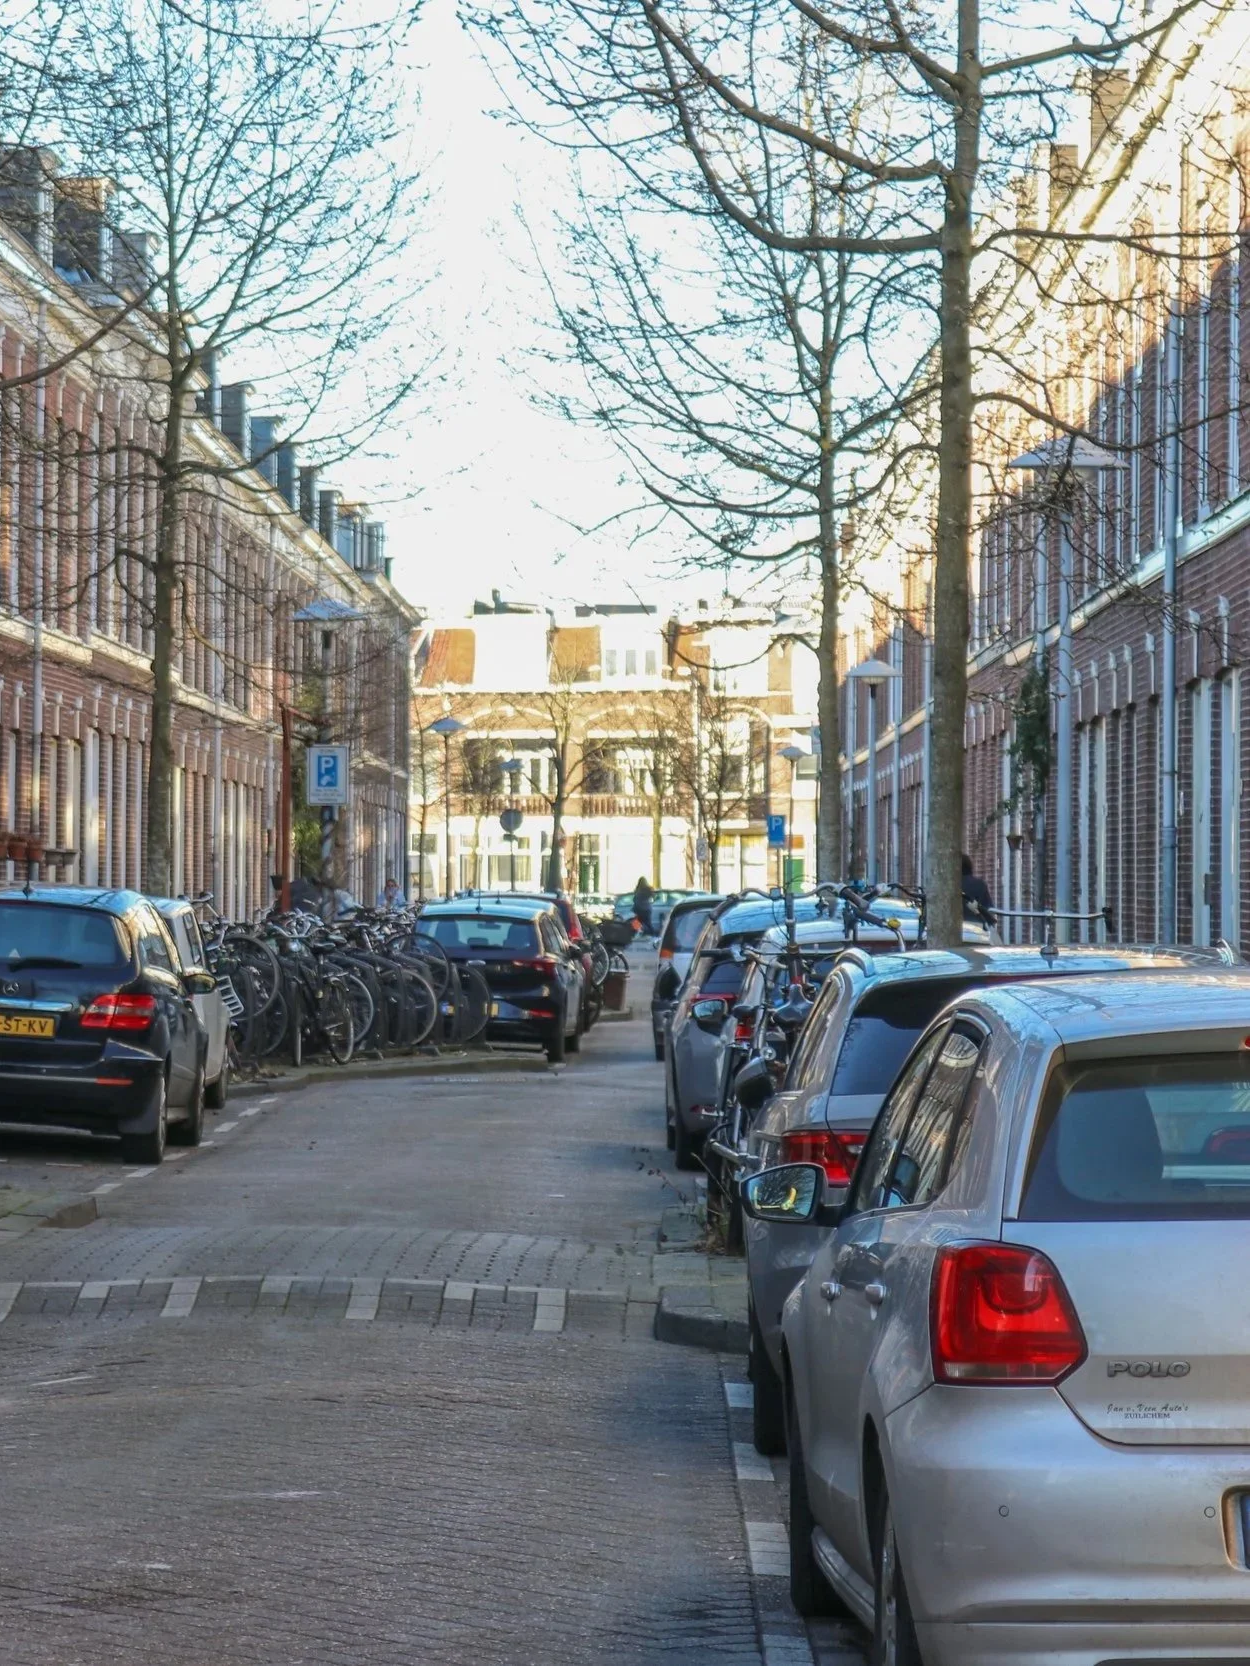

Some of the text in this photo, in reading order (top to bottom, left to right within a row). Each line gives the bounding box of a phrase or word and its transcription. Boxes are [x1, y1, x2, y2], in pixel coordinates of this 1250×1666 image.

[321, 756, 335, 774] P
[771, 816, 783, 831] P
[1107, 1361, 1191, 1378] POLO
[1107, 1403, 1124, 1414] Jan
[1160, 1403, 1189, 1412] Auto's
[1123, 1412, 1171, 1420] ZUILICHEM
